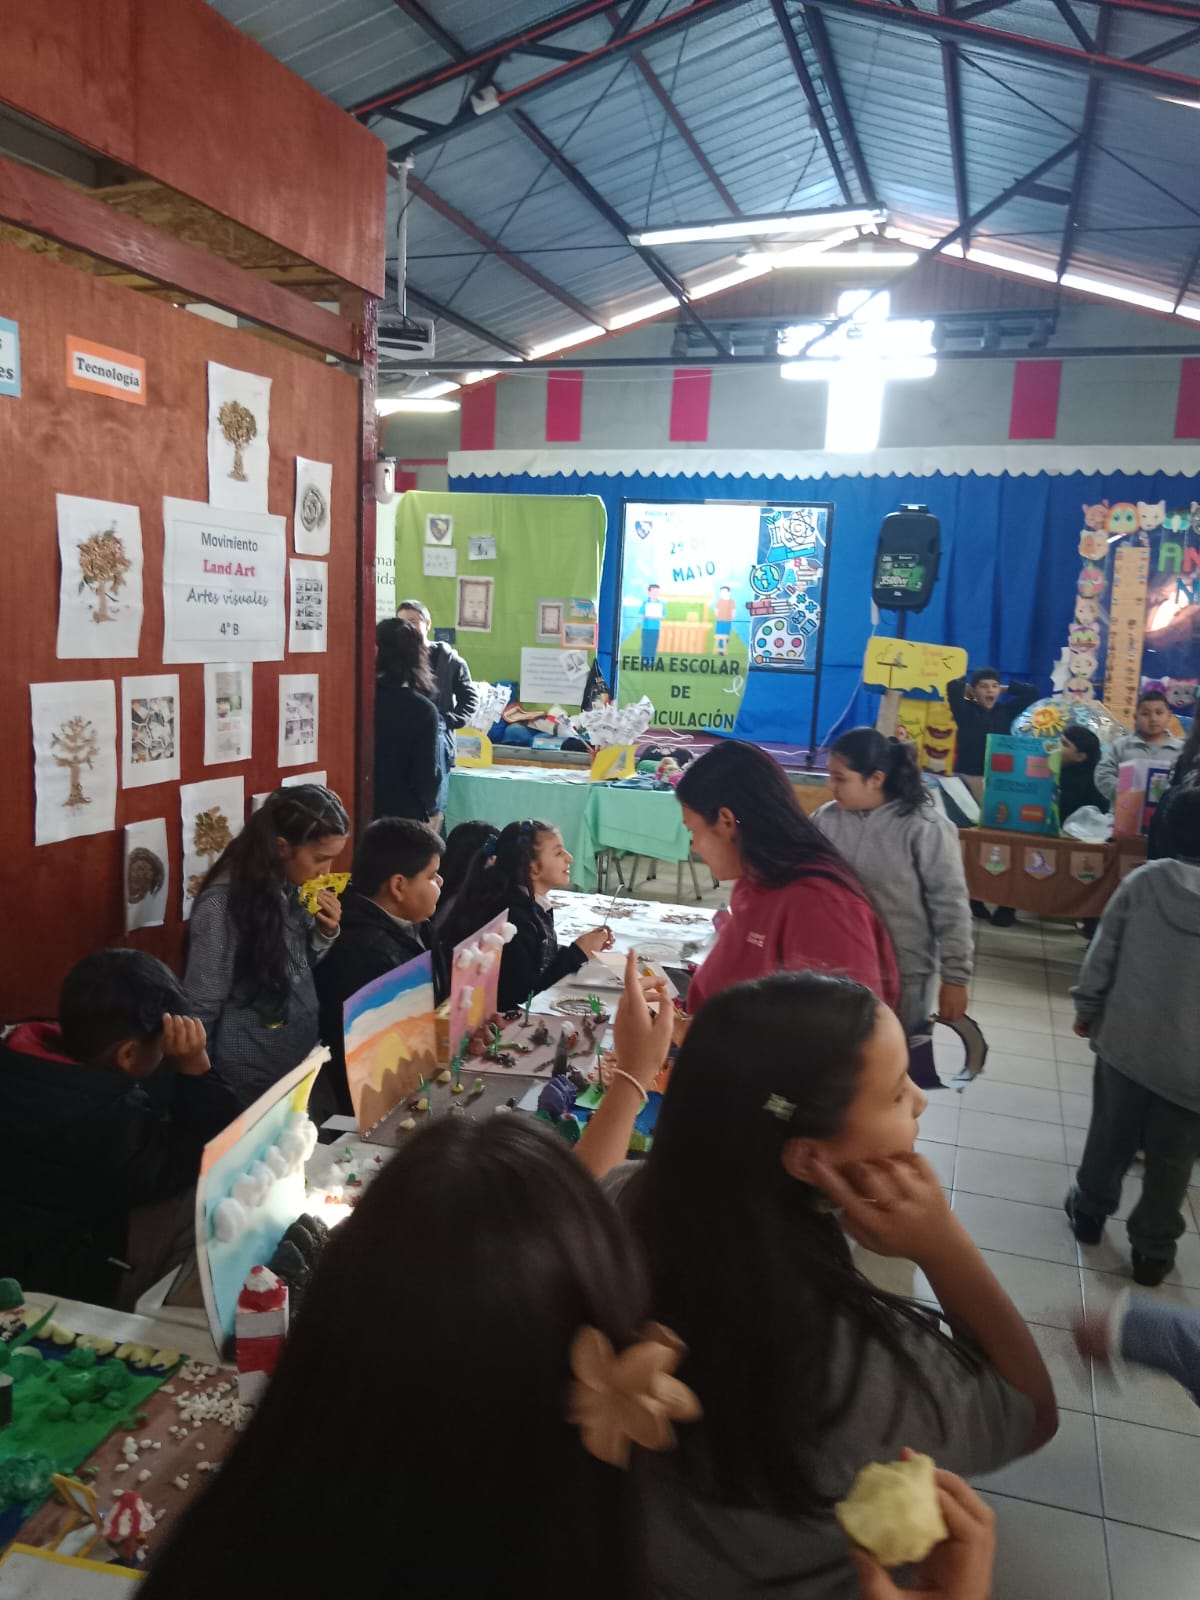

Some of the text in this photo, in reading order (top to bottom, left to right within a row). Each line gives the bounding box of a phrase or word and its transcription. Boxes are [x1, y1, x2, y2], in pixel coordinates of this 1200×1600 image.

[201, 531, 258, 552] Movimiento
[203, 559, 256, 577] Land Art
[186, 587, 269, 608] Artes visuales
[621, 655, 740, 676] FERIA ESCOLAR
[670, 685, 691, 699] DE
[648, 708, 735, 729] ICULACIÓN
